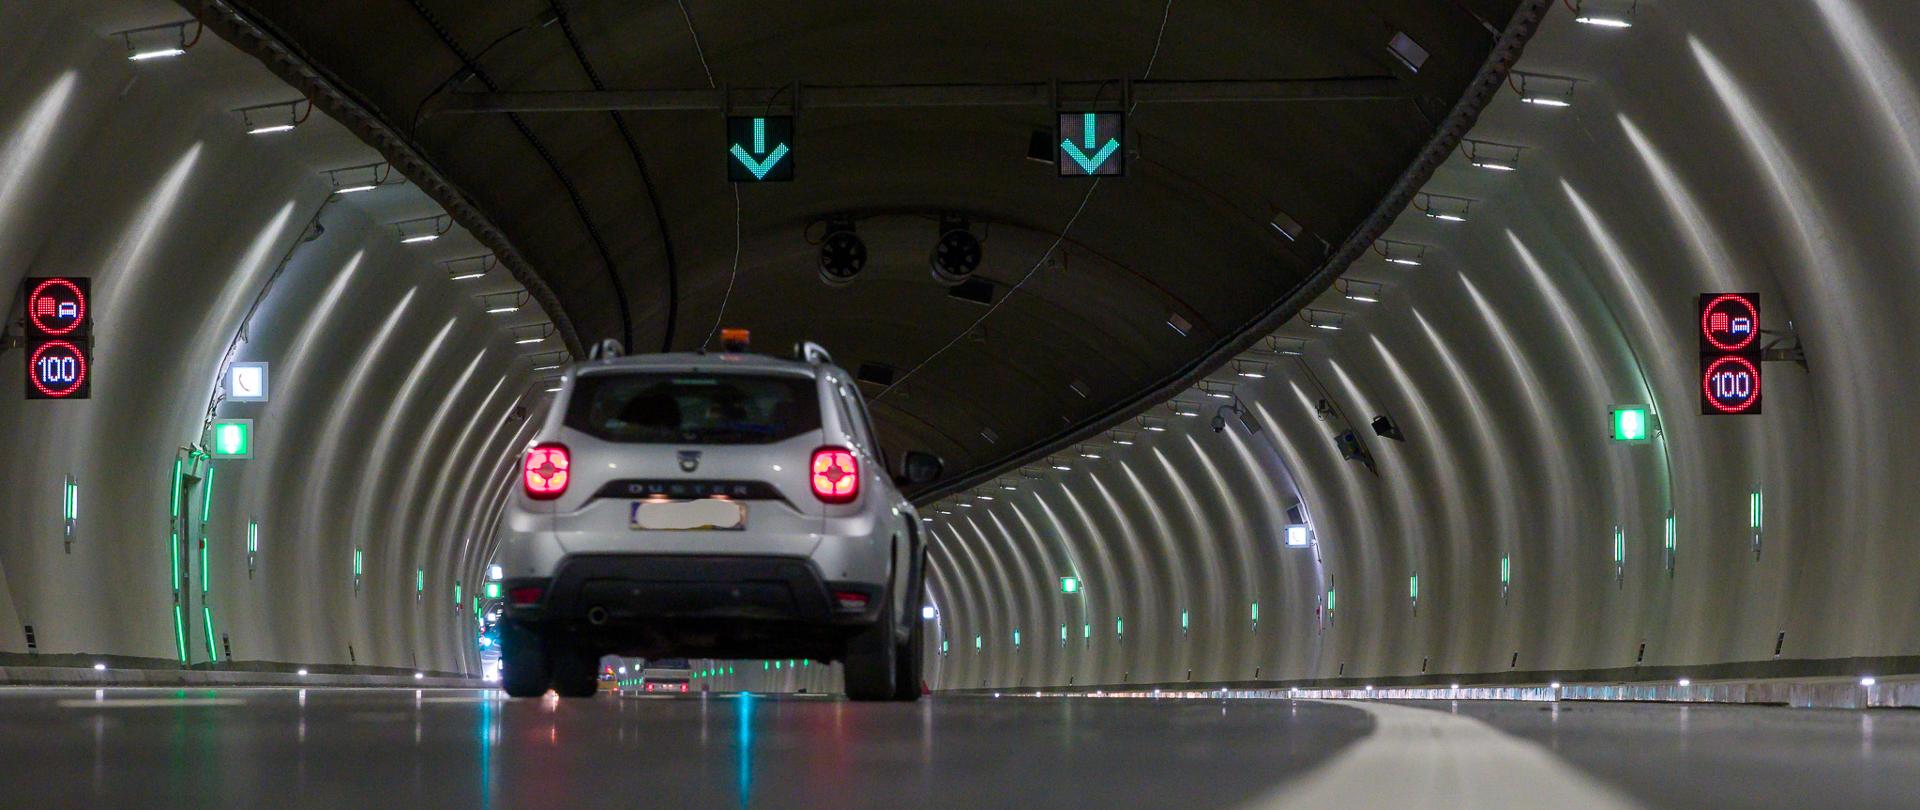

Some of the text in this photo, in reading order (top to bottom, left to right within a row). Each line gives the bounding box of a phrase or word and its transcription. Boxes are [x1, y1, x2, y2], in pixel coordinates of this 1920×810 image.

[38, 356, 75, 382] 100
[1712, 371, 1749, 398] 100
[628, 483, 748, 495] DUSTER
